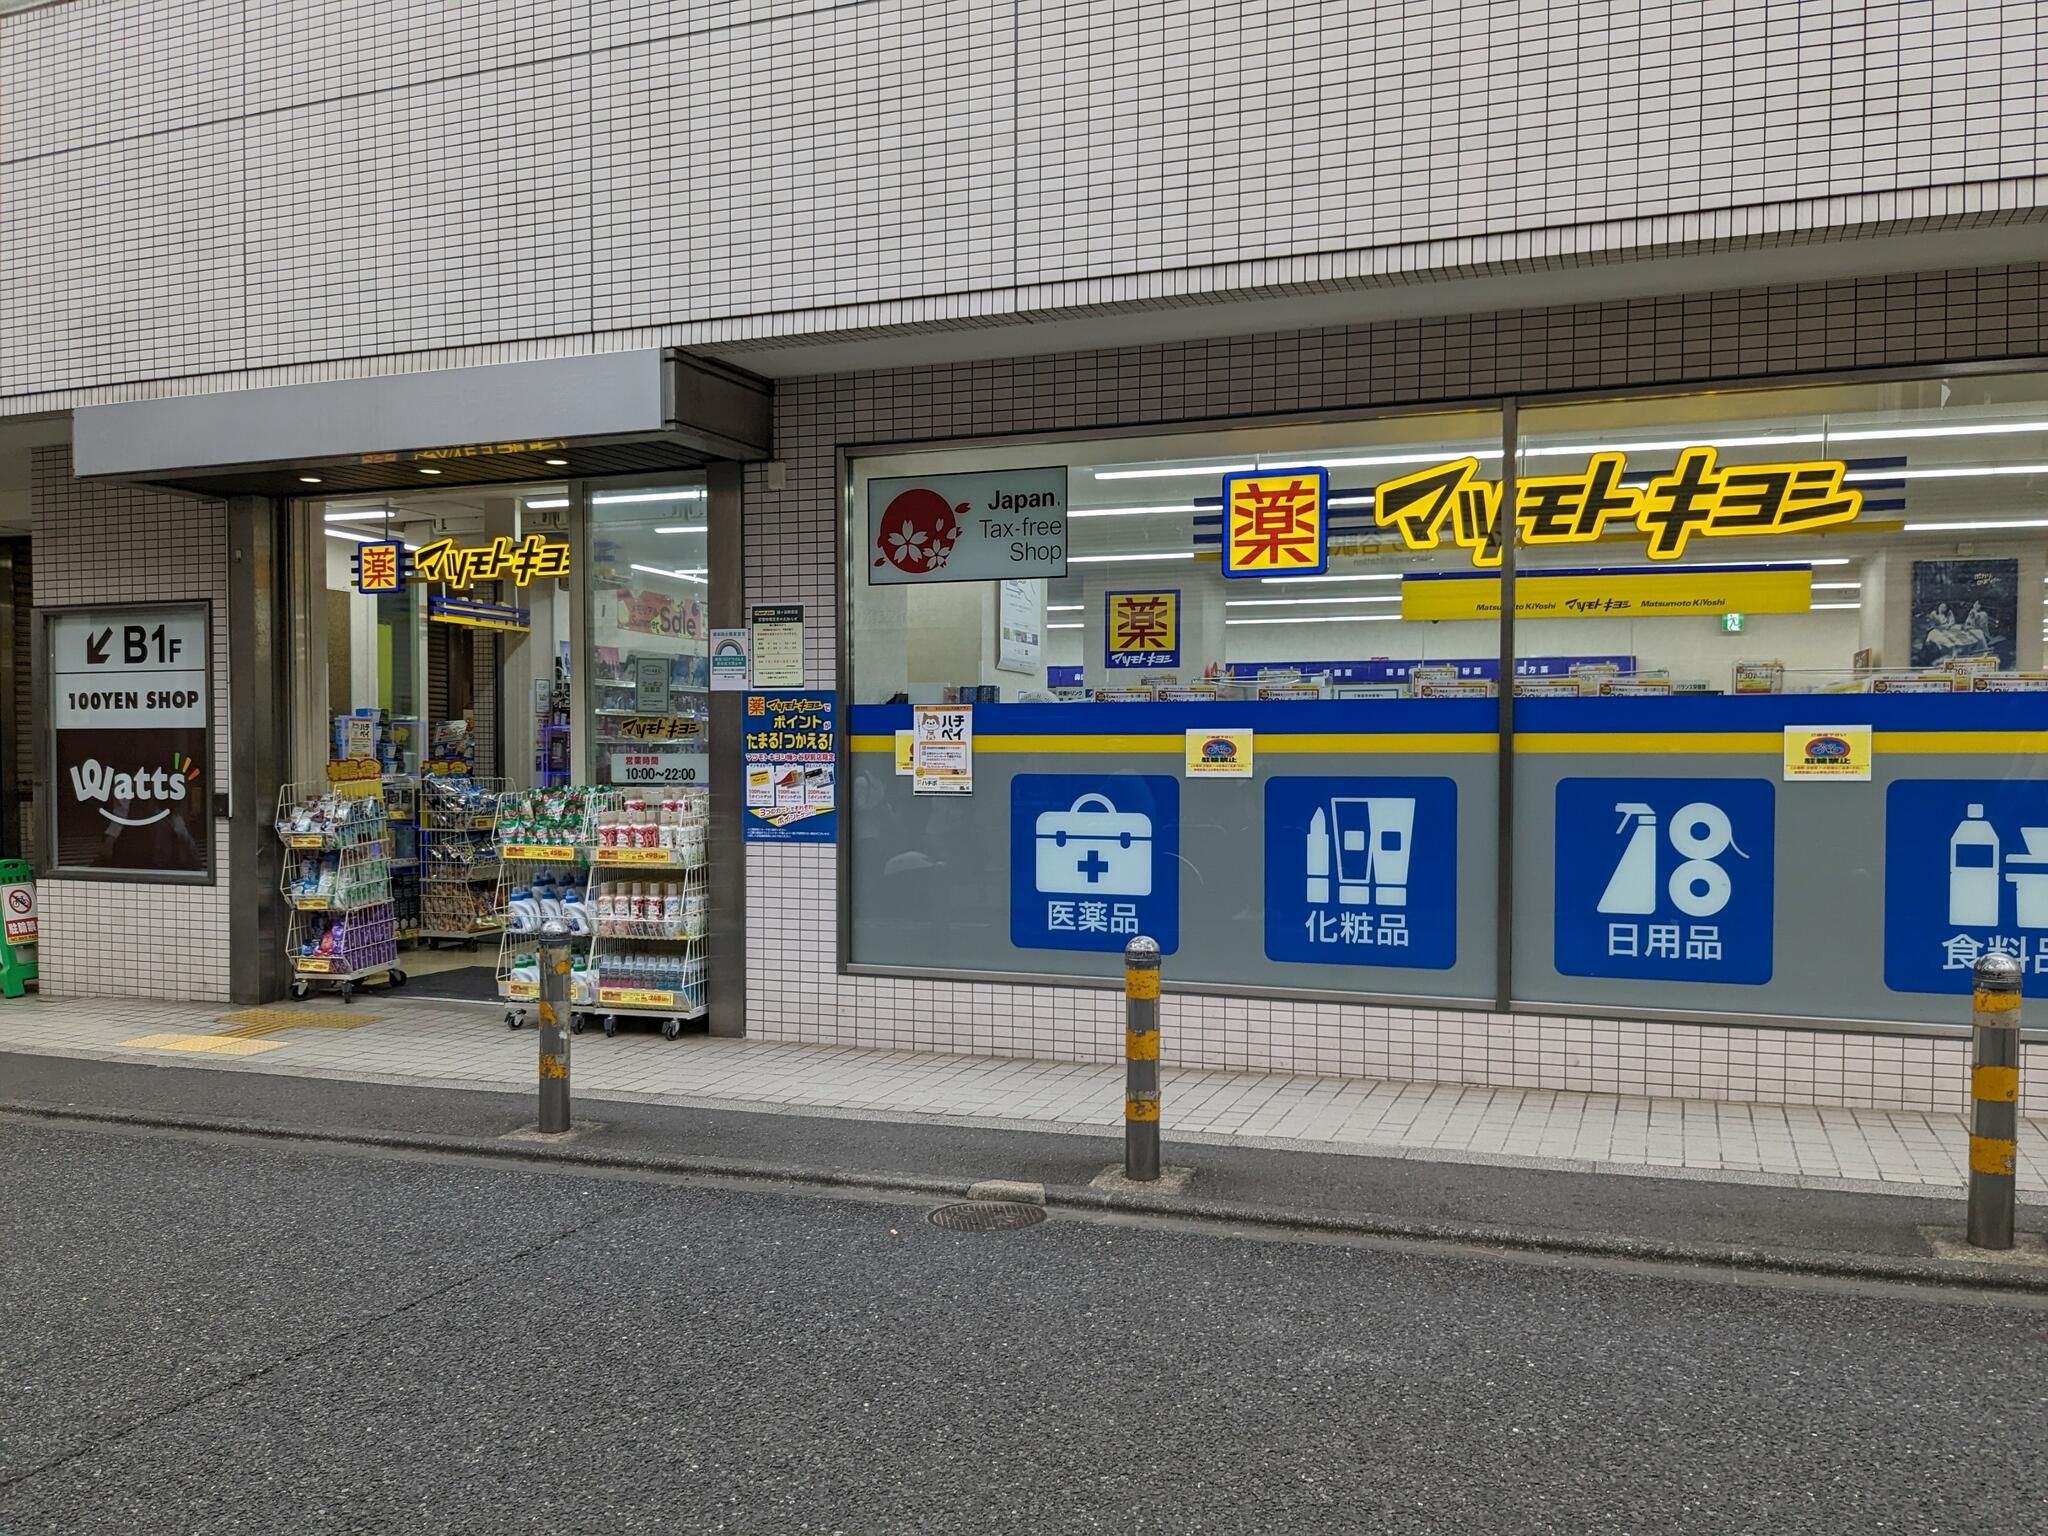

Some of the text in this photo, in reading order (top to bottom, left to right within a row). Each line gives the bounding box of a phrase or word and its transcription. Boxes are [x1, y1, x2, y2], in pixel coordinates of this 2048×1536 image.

[979, 517, 1062, 539] Tax-free
[1235, 481, 1315, 566] 薬
[363, 535, 570, 589] 薬 マツモトキヨ
[1009, 542, 1062, 565] Shop
[1525, 602, 1557, 611] KiYoshi
[1565, 598, 1632, 612] マツモトキヨシ
[1641, 599, 1692, 608] Matsumoto
[1693, 598, 1726, 607] KiYoshi
[660, 606, 697, 636] Sale
[1116, 597, 1169, 648] 薬
[123, 624, 182, 664] B1F
[1111, 652, 1173, 666] マツモトキヨシ
[68, 690, 199, 710] 100YEN SHOP
[748, 697, 765, 715] 薬
[622, 719, 700, 738] マツモトキヨシ
[942, 715, 965, 728] ハチ
[941, 728, 965, 741] ペイ
[625, 756, 659, 766] 営業時間
[69, 758, 186, 802] Watts
[1047, 901, 1140, 935] 医薬品
[1304, 910, 1410, 948] 化粧品
[1609, 922, 1724, 961] 日用品
